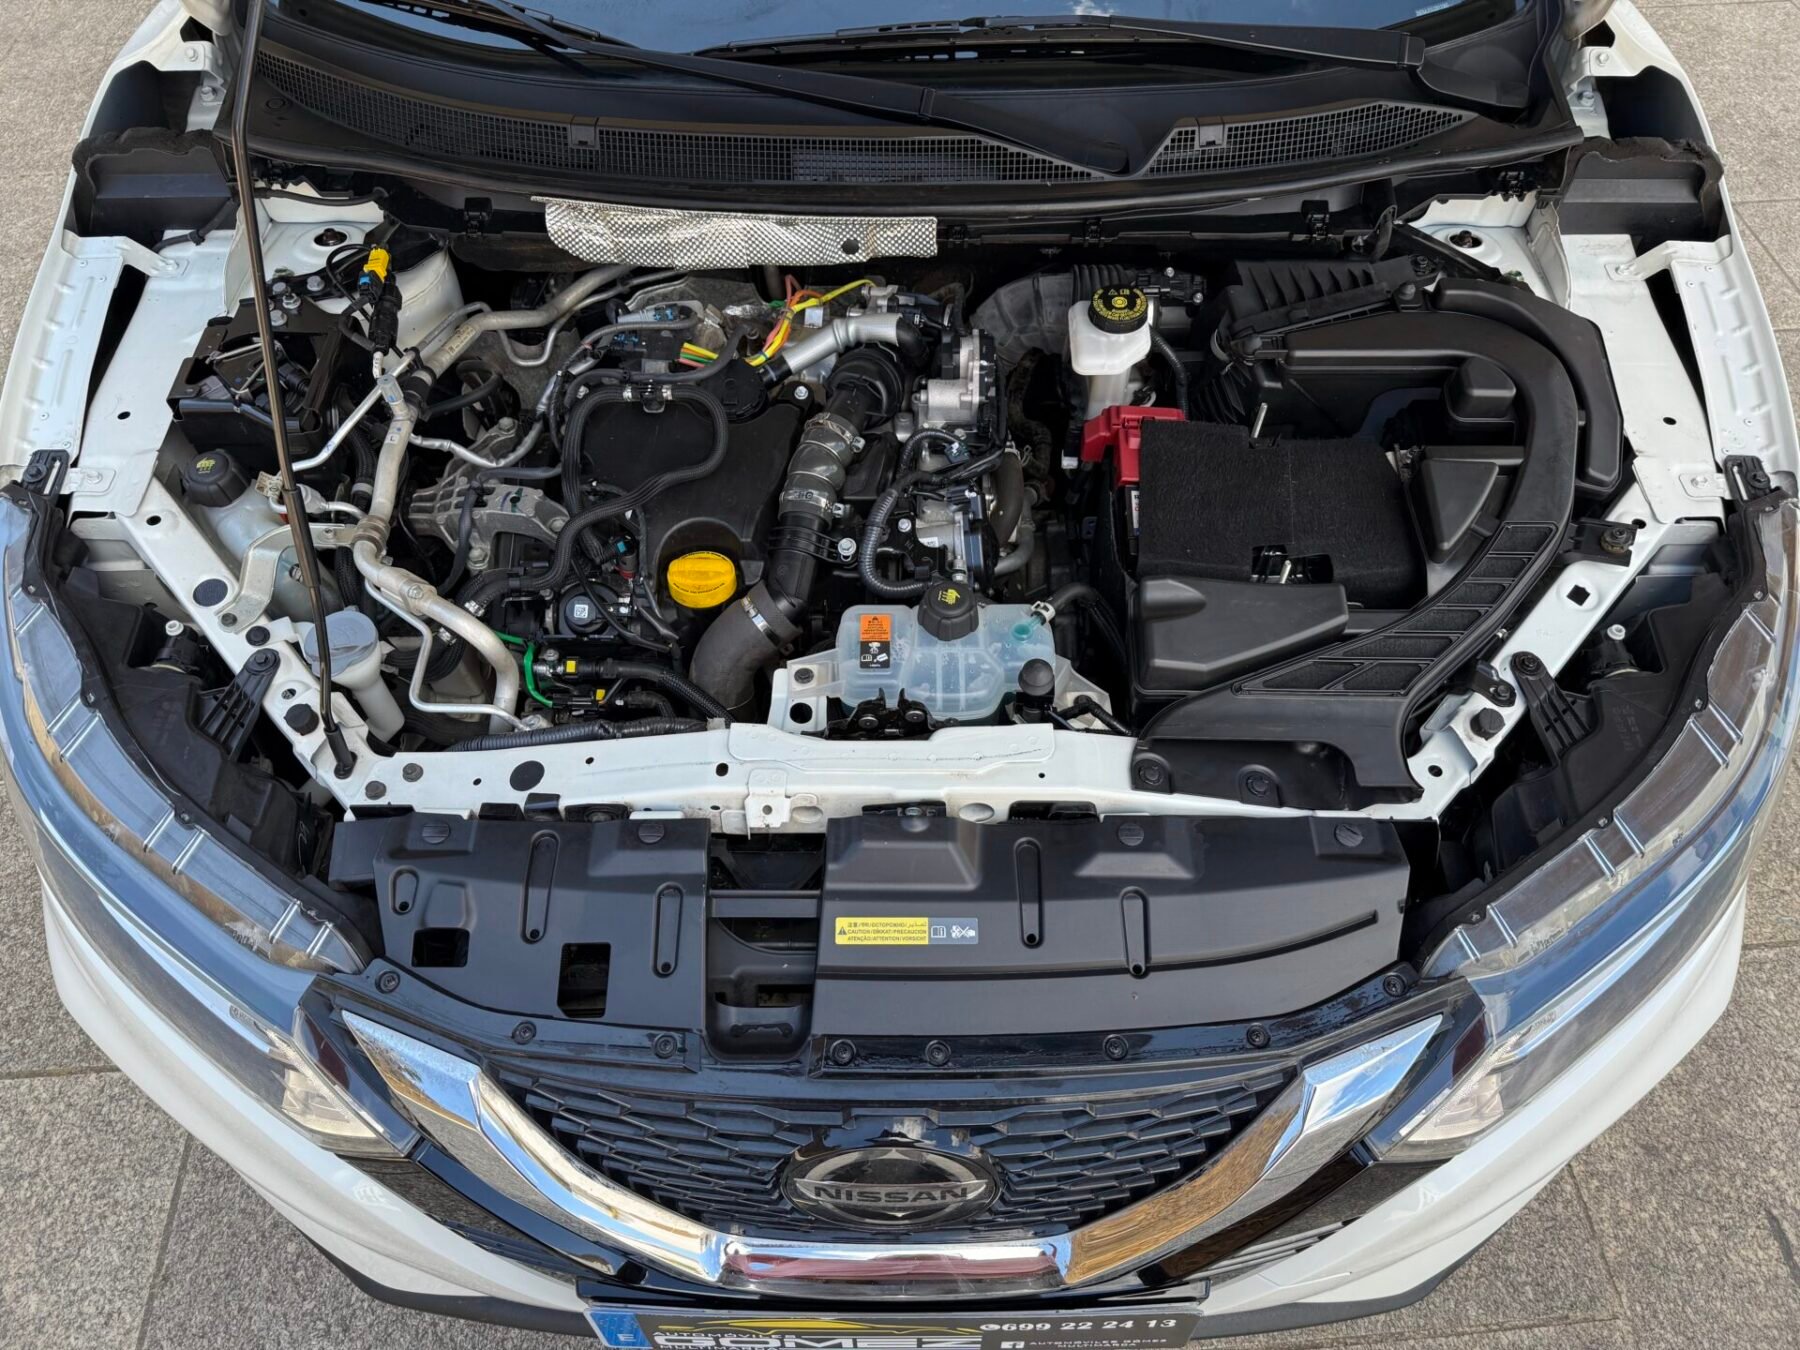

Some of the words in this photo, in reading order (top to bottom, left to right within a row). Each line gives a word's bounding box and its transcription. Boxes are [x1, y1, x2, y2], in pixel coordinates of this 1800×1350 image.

[814, 1186, 968, 1203] NISSAN
[1001, 1322, 1051, 1331] 699
[1060, 1321, 1093, 1330] 22
[1102, 1320, 1134, 1329] 24
[1146, 1319, 1177, 1328] 13
[619, 1333, 636, 1342] E
